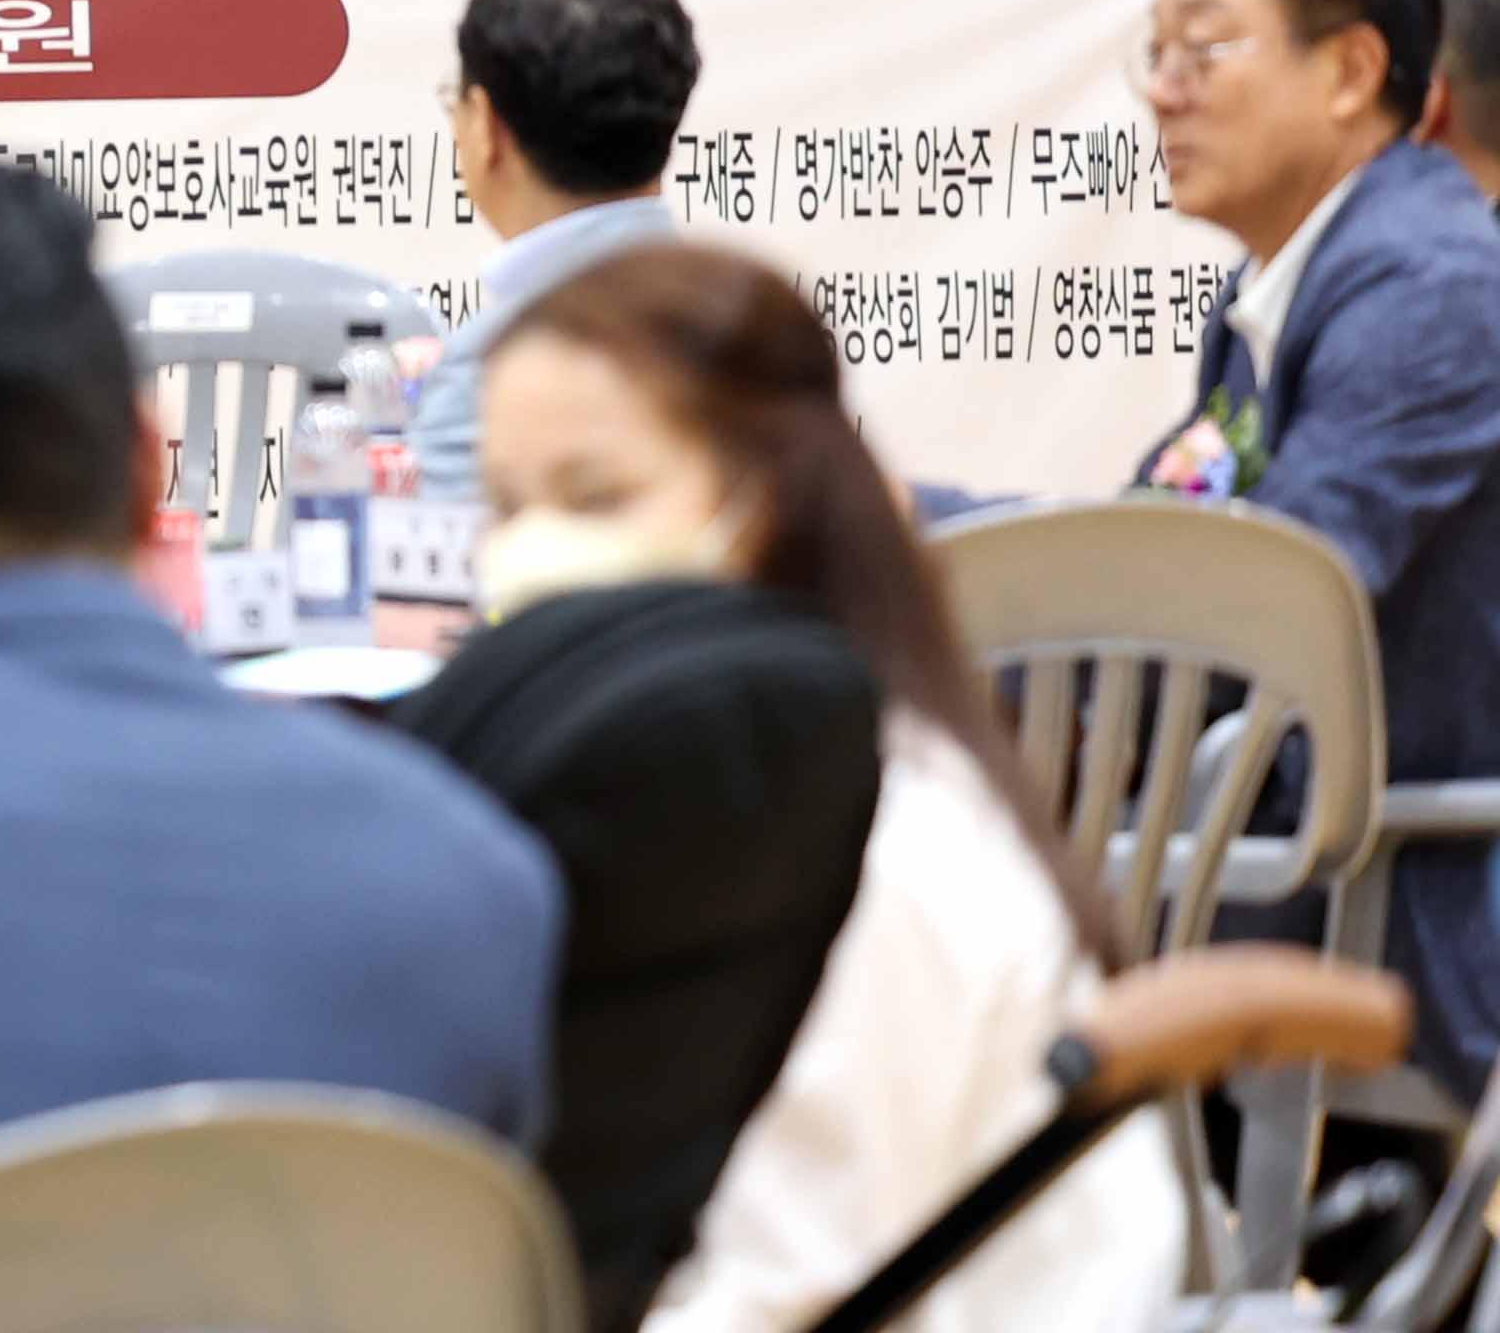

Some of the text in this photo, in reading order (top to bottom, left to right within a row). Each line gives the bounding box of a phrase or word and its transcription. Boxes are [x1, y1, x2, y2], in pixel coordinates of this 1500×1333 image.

[332, 133, 413, 229] 권덕진
[675, 128, 756, 224] 구재중
[794, 125, 903, 222] 명가반찬
[915, 124, 993, 220] 안승주
[1031, 121, 1140, 215] 무즈빠야
[936, 268, 1015, 363] 김기범
[1053, 264, 1157, 360] 영창식품
